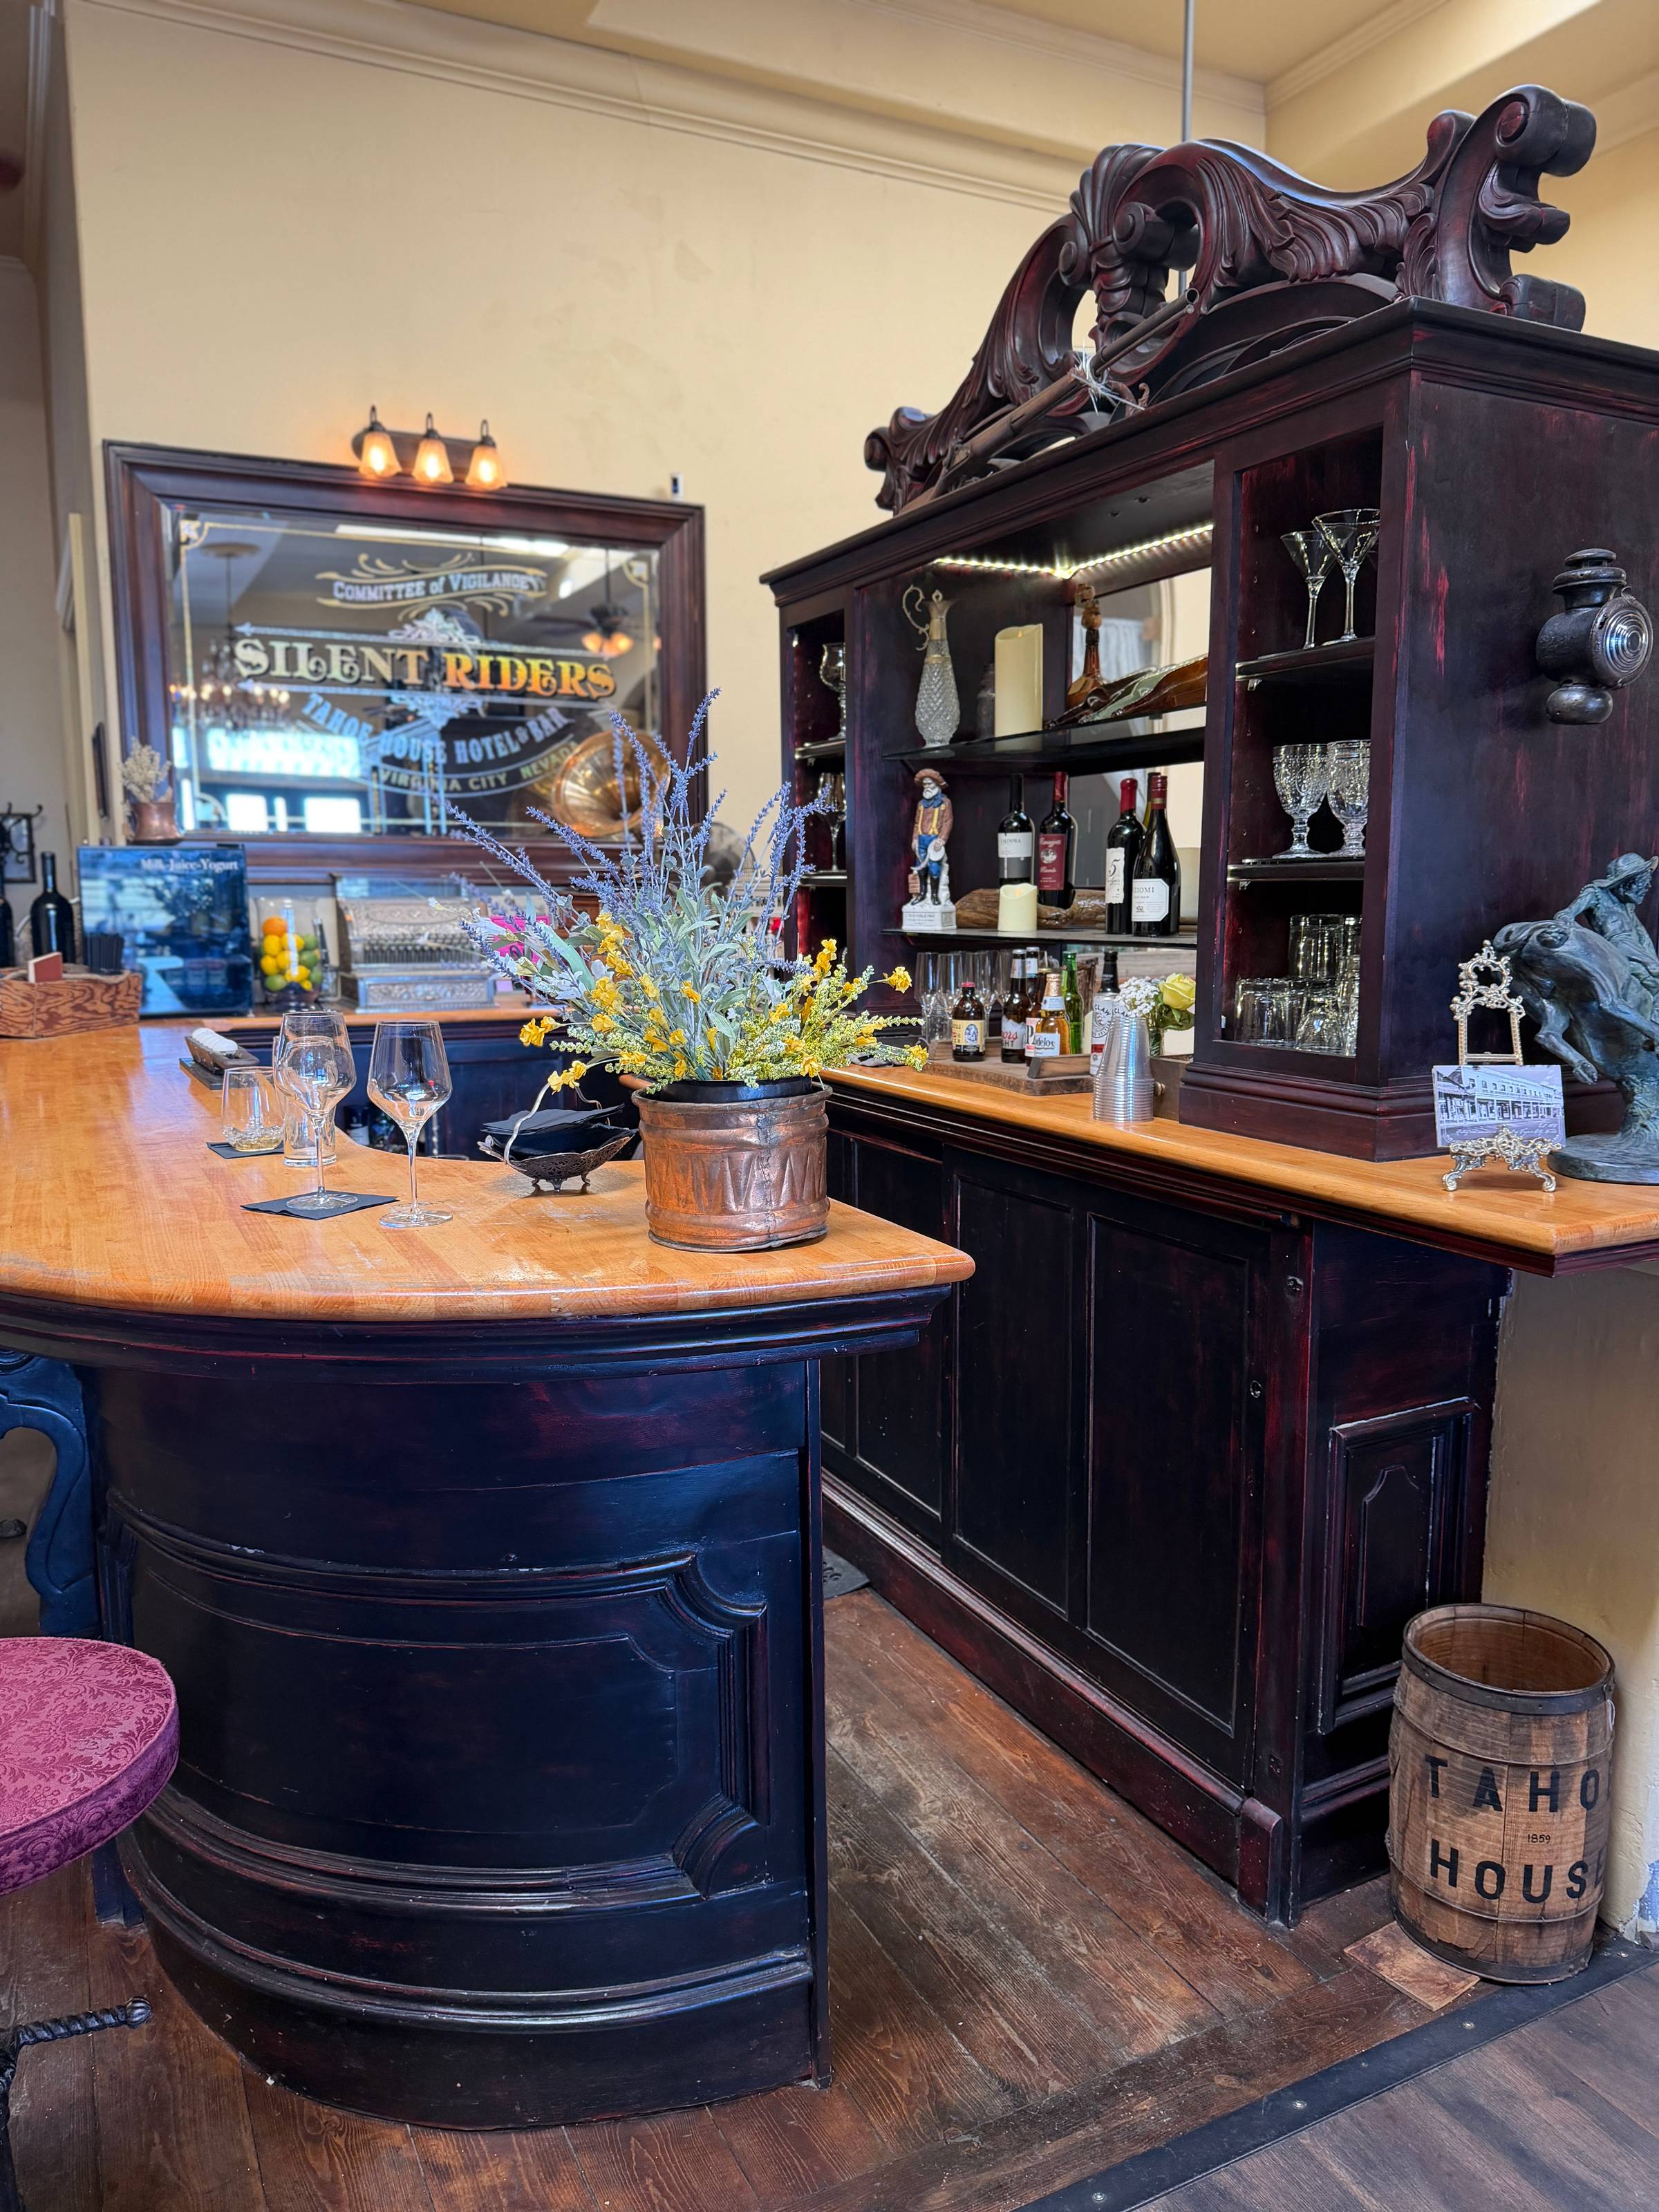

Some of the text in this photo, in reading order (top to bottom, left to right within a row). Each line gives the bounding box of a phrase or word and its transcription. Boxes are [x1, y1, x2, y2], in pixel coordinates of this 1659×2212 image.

[333, 580, 426, 601] COMMITTEE
[429, 575, 447, 594] of
[234, 638, 618, 700] SILENT RIDERS
[301, 692, 373, 744] TAHOE
[378, 731, 447, 764] HOUSE
[468, 772, 507, 790] CITY
[1094, 1004, 1112, 1015] CLAW
[1425, 1755, 1611, 1813] TAHO
[1527, 1834, 1551, 1845] 1859
